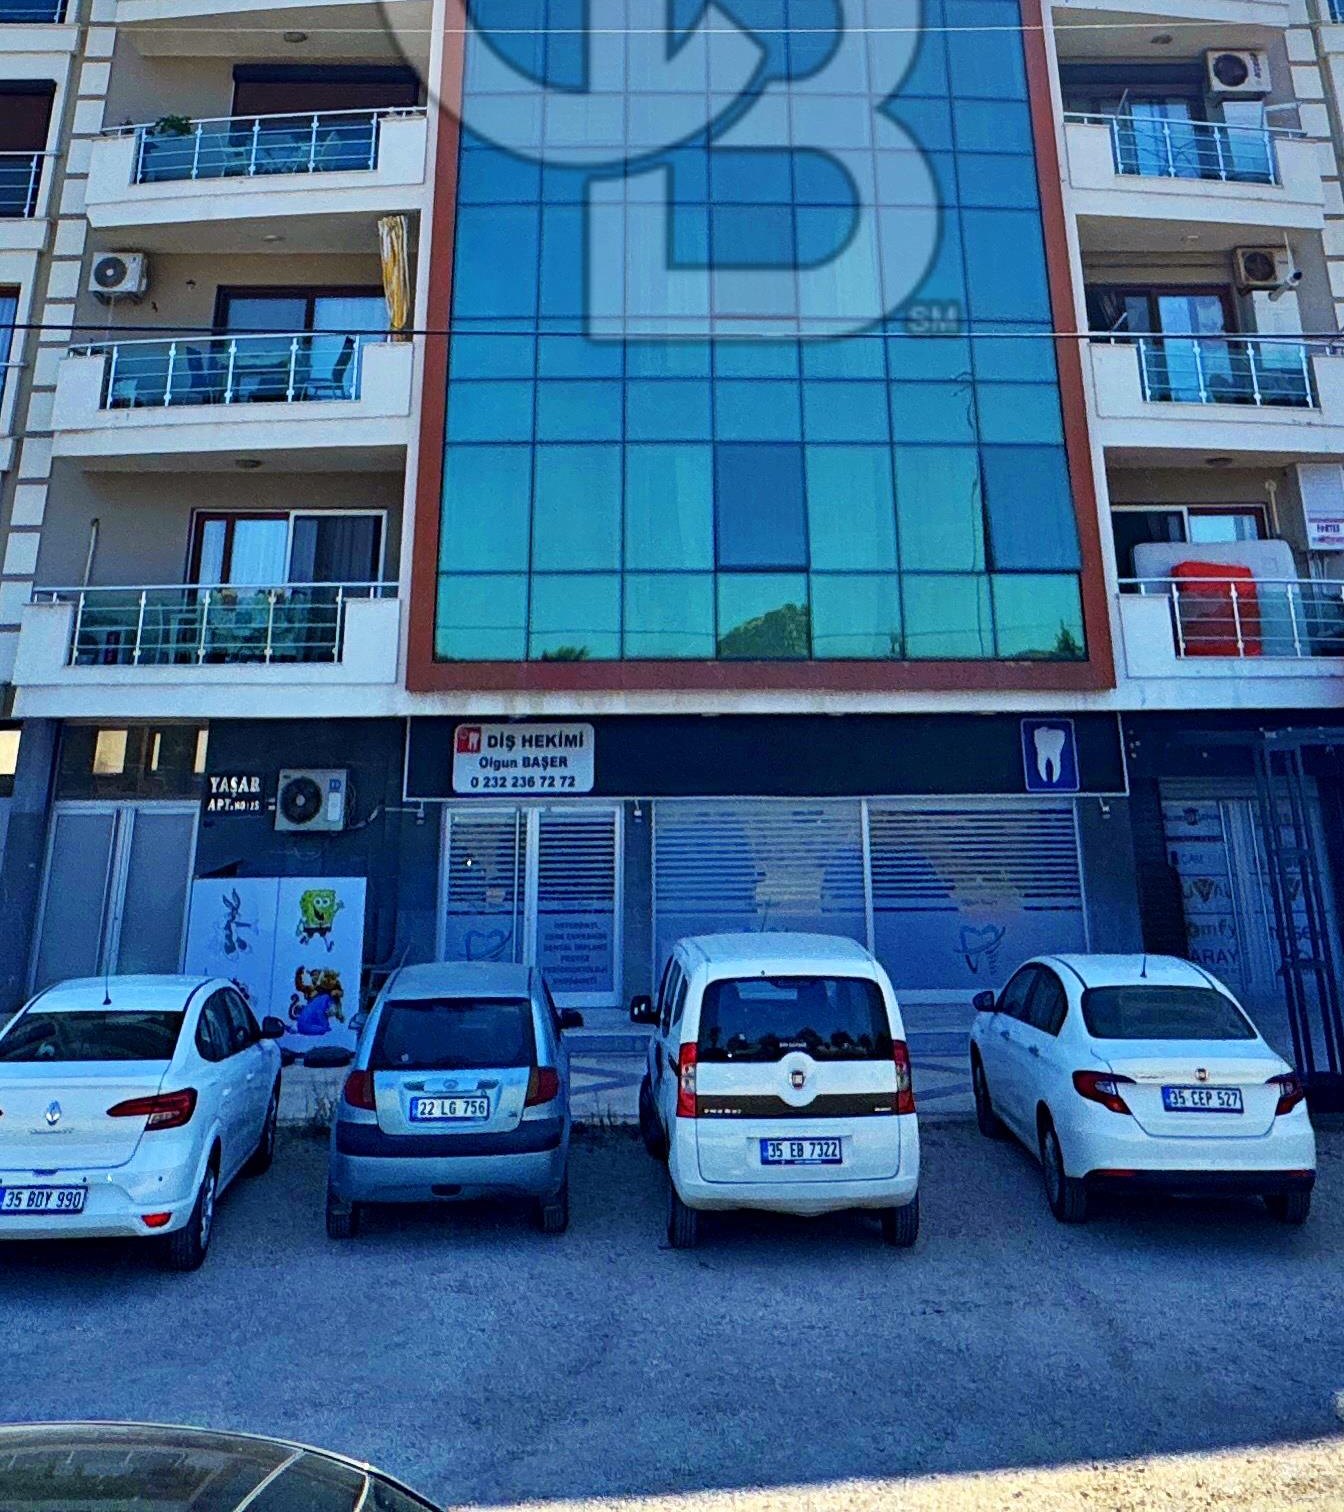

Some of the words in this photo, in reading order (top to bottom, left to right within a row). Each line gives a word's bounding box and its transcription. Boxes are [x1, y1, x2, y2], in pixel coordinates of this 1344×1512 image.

[487, 731, 516, 752] DİŞ
[521, 730, 584, 749] HEKİMİ
[478, 756, 518, 771] Olgun
[522, 756, 568, 771] BAŞER
[470, 776, 479, 788] 0
[483, 776, 507, 788] 232
[511, 776, 536, 788] 236
[539, 776, 555, 788] 72
[559, 776, 576, 788] 72
[1170, 1090, 1186, 1106] 35
[1191, 1090, 1212, 1107] CEP
[1217, 1089, 1239, 1107] 527
[419, 1101, 435, 1116] 22
[440, 1101, 457, 1115] LG
[463, 1100, 486, 1115] 756
[769, 1142, 783, 1158] 35
[789, 1142, 804, 1158] EB
[809, 1141, 838, 1158] 7322
[6, 1190, 22, 1208] 35
[26, 1191, 52, 1208] BDY
[56, 1191, 81, 1208] 990
